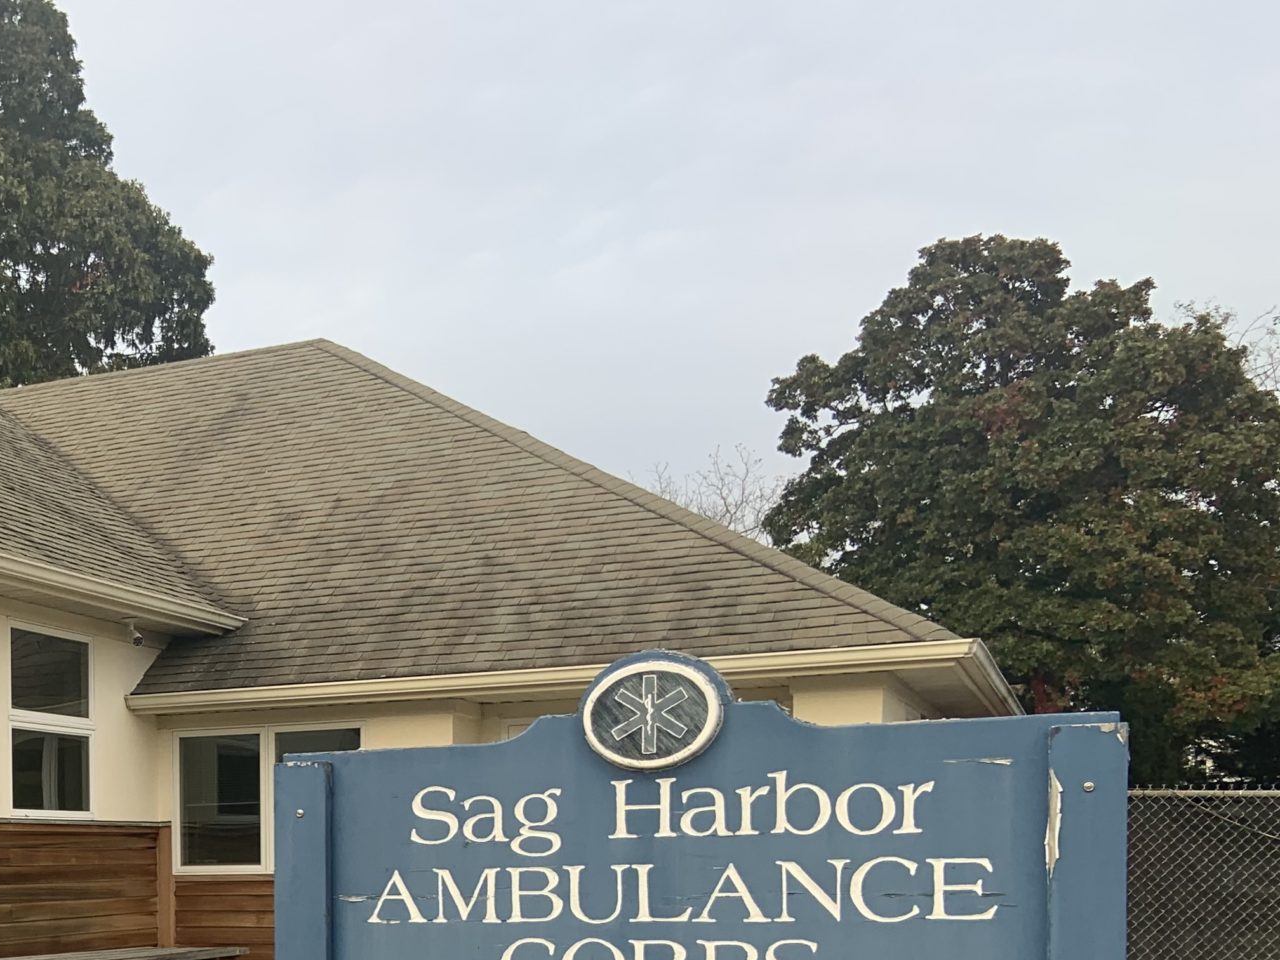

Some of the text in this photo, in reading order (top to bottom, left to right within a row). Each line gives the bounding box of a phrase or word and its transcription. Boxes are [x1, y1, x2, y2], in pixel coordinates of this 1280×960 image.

[410, 770, 935, 857] Sag Harbor
[367, 856, 999, 925] AMBULANCE
